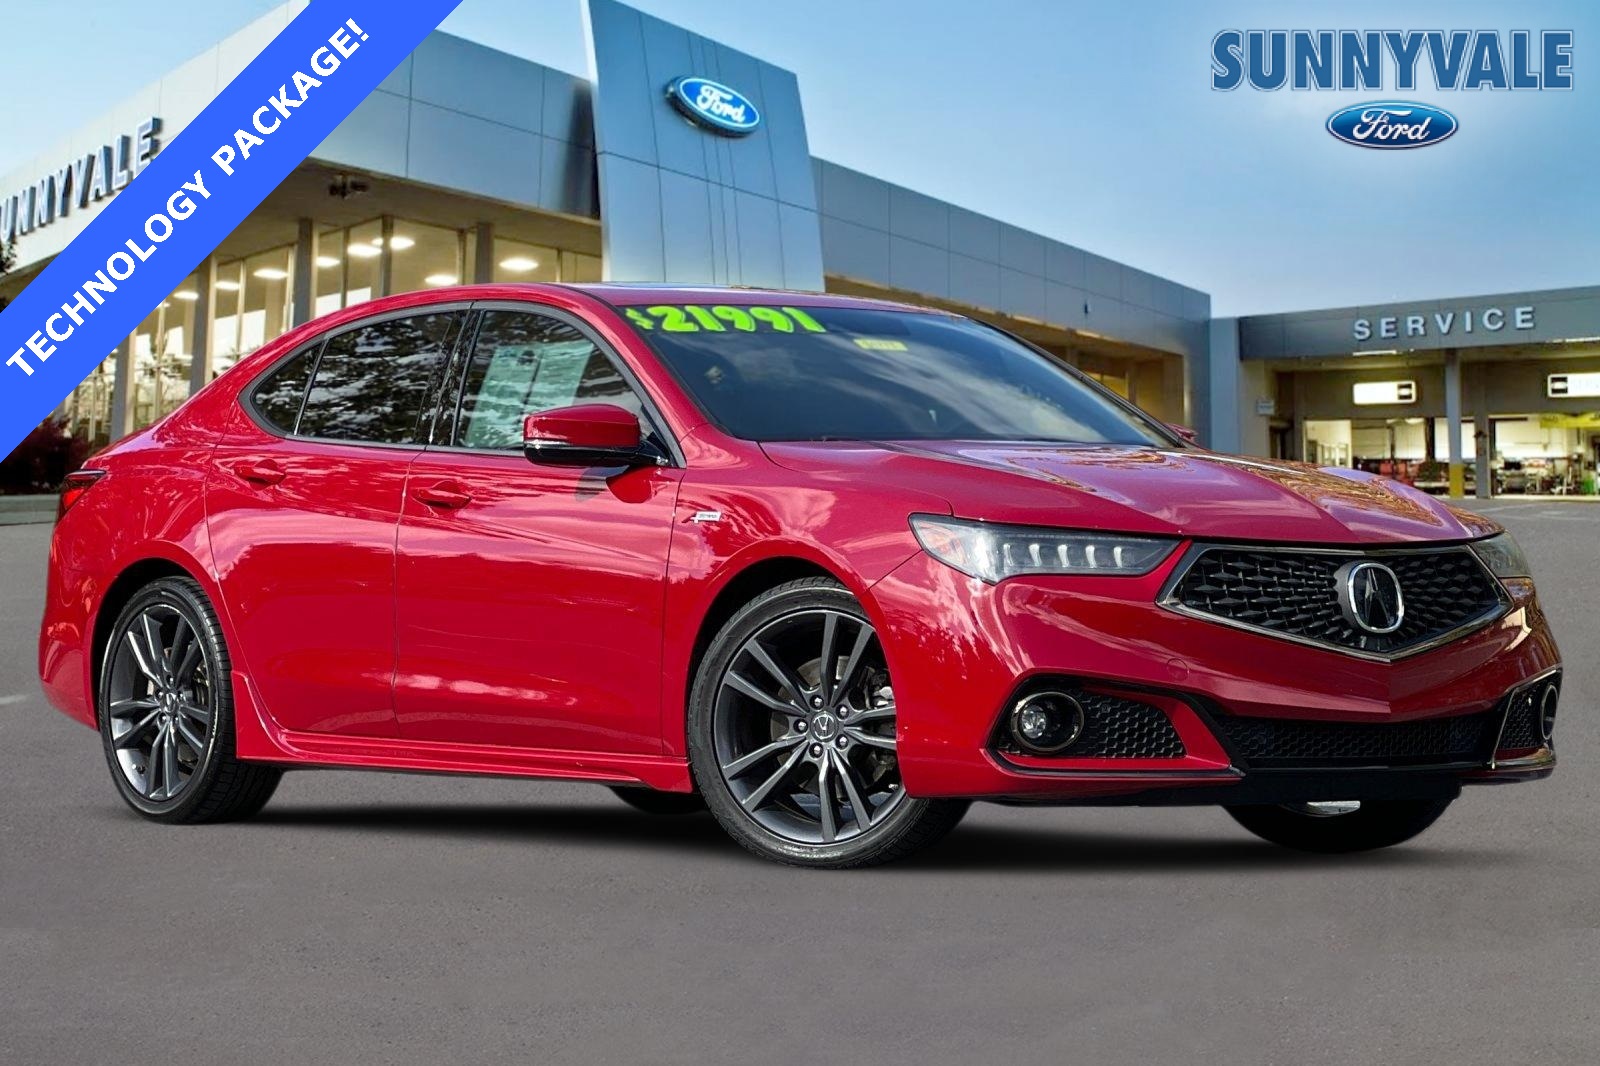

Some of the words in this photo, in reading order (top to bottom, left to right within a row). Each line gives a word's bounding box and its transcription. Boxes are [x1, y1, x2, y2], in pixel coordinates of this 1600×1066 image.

[697, 85, 745, 123] Ford
[0, 117, 161, 243] UNNYVALE
[626, 305, 826, 332] $21991
[1354, 306, 1535, 341] SERVICE
